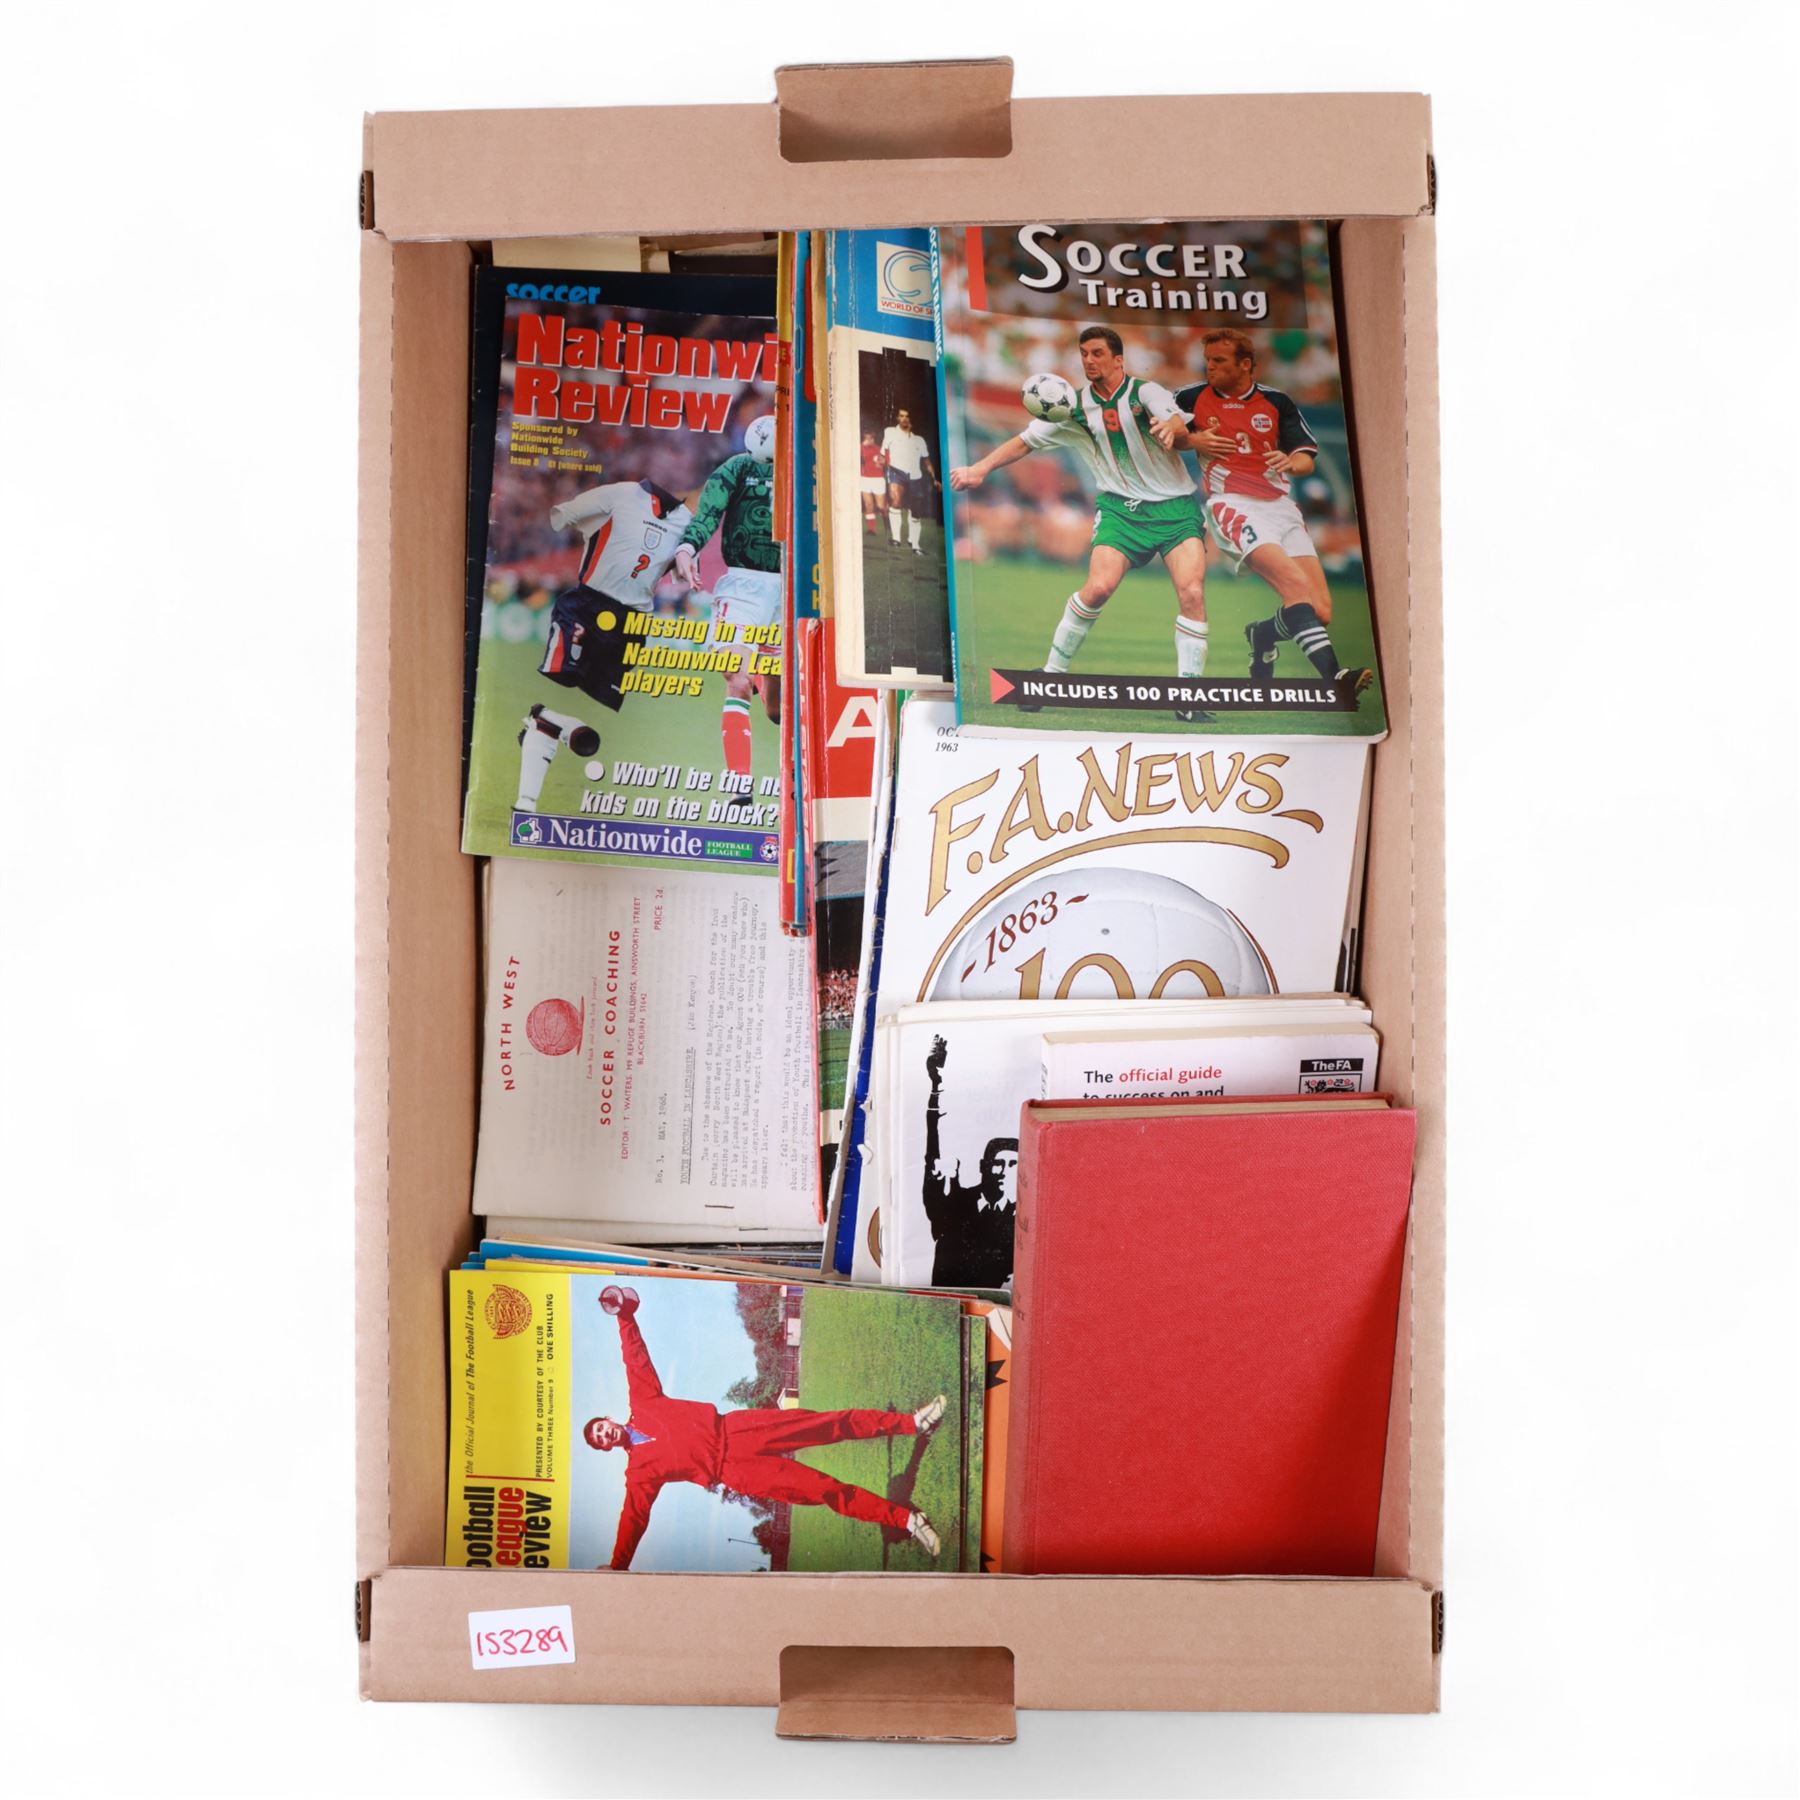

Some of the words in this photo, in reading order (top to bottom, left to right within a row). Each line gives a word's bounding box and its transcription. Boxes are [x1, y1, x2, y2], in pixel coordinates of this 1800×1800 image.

[1017, 224, 1248, 288] SOCCER
[506, 283, 601, 304] soccer
[881, 301, 911, 311] WORLD
[1078, 278, 1269, 320] Training
[931, 282, 943, 362] TRAINING
[513, 367, 733, 434] Review
[511, 421, 563, 433] Sponsored
[566, 426, 578, 437] by
[511, 432, 563, 444] Nationwide
[510, 443, 548, 455] Building
[552, 446, 588, 459] Society
[1235, 432, 1252, 455] 3
[510, 456, 531, 466] Issue
[1241, 525, 1258, 544] 3
[623, 612, 708, 644] Missing
[714, 617, 737, 643] in
[622, 642, 742, 673] Nationwide
[620, 670, 703, 697] players
[1023, 681, 1119, 700] INCLUDES
[1126, 686, 1161, 701] 100
[1167, 686, 1263, 703] PRACTICE
[1270, 687, 1336, 703] DRILLS
[936, 742, 958, 752] 1963
[612, 761, 679, 789] Who'll
[687, 765, 713, 791] be
[717, 768, 754, 795] the
[580, 790, 626, 815] kids
[634, 796, 658, 818] on
[666, 796, 701, 822] the
[706, 800, 778, 827] block?
[547, 819, 702, 857] Nationwide
[707, 841, 752, 850] FOOTBALL
[707, 848, 740, 856] LEAGUE
[633, 897, 641, 924] STREET
[654, 905, 663, 930] PRICE
[710, 932, 718, 946] the
[631, 928, 640, 976] AINSWORTH
[709, 951, 718, 966] for
[502, 955, 520, 1009] WEST
[604, 930, 620, 1035] COACHING
[627, 1027, 635, 1056] REFUGE
[637, 1018, 646, 1065] BLACKBURN
[704, 1042, 712, 1056] the
[500, 1023, 516, 1091] NORTH
[1084, 1070, 1113, 1083] The
[1119, 1067, 1173, 1083] official
[1178, 1066, 1223, 1084] guide
[600, 1050, 614, 1126] SOCCER
[1196, 1085, 1224, 1097] and
[684, 1103, 692, 1112] IN
[702, 1114, 710, 1128] the
[682, 1116, 692, 1156] FOOTBALL
[655, 1170, 664, 1184] No.
[680, 1158, 690, 1184] YOUTH
[466, 1289, 476, 1321] League
[546, 1293, 554, 1338] SHILLING
[465, 1322, 475, 1360] Football
[536, 1325, 544, 1345] CLUB
[536, 1349, 544, 1363] THE
[546, 1340, 554, 1360] ONE
[466, 1362, 475, 1378] The
[536, 1367, 544, 1376] OF
[466, 1380, 475, 1390] of
[466, 1392, 475, 1424] Journal
[536, 1380, 544, 1418] COURTESY
[536, 1422, 544, 1432] BY
[465, 1427, 475, 1457] Official
[464, 1460, 474, 1474] the
[536, 1436, 544, 1478] PRESENTED
[546, 1444, 554, 1478] VOLUME
[495, 1487, 528, 1568] eague
